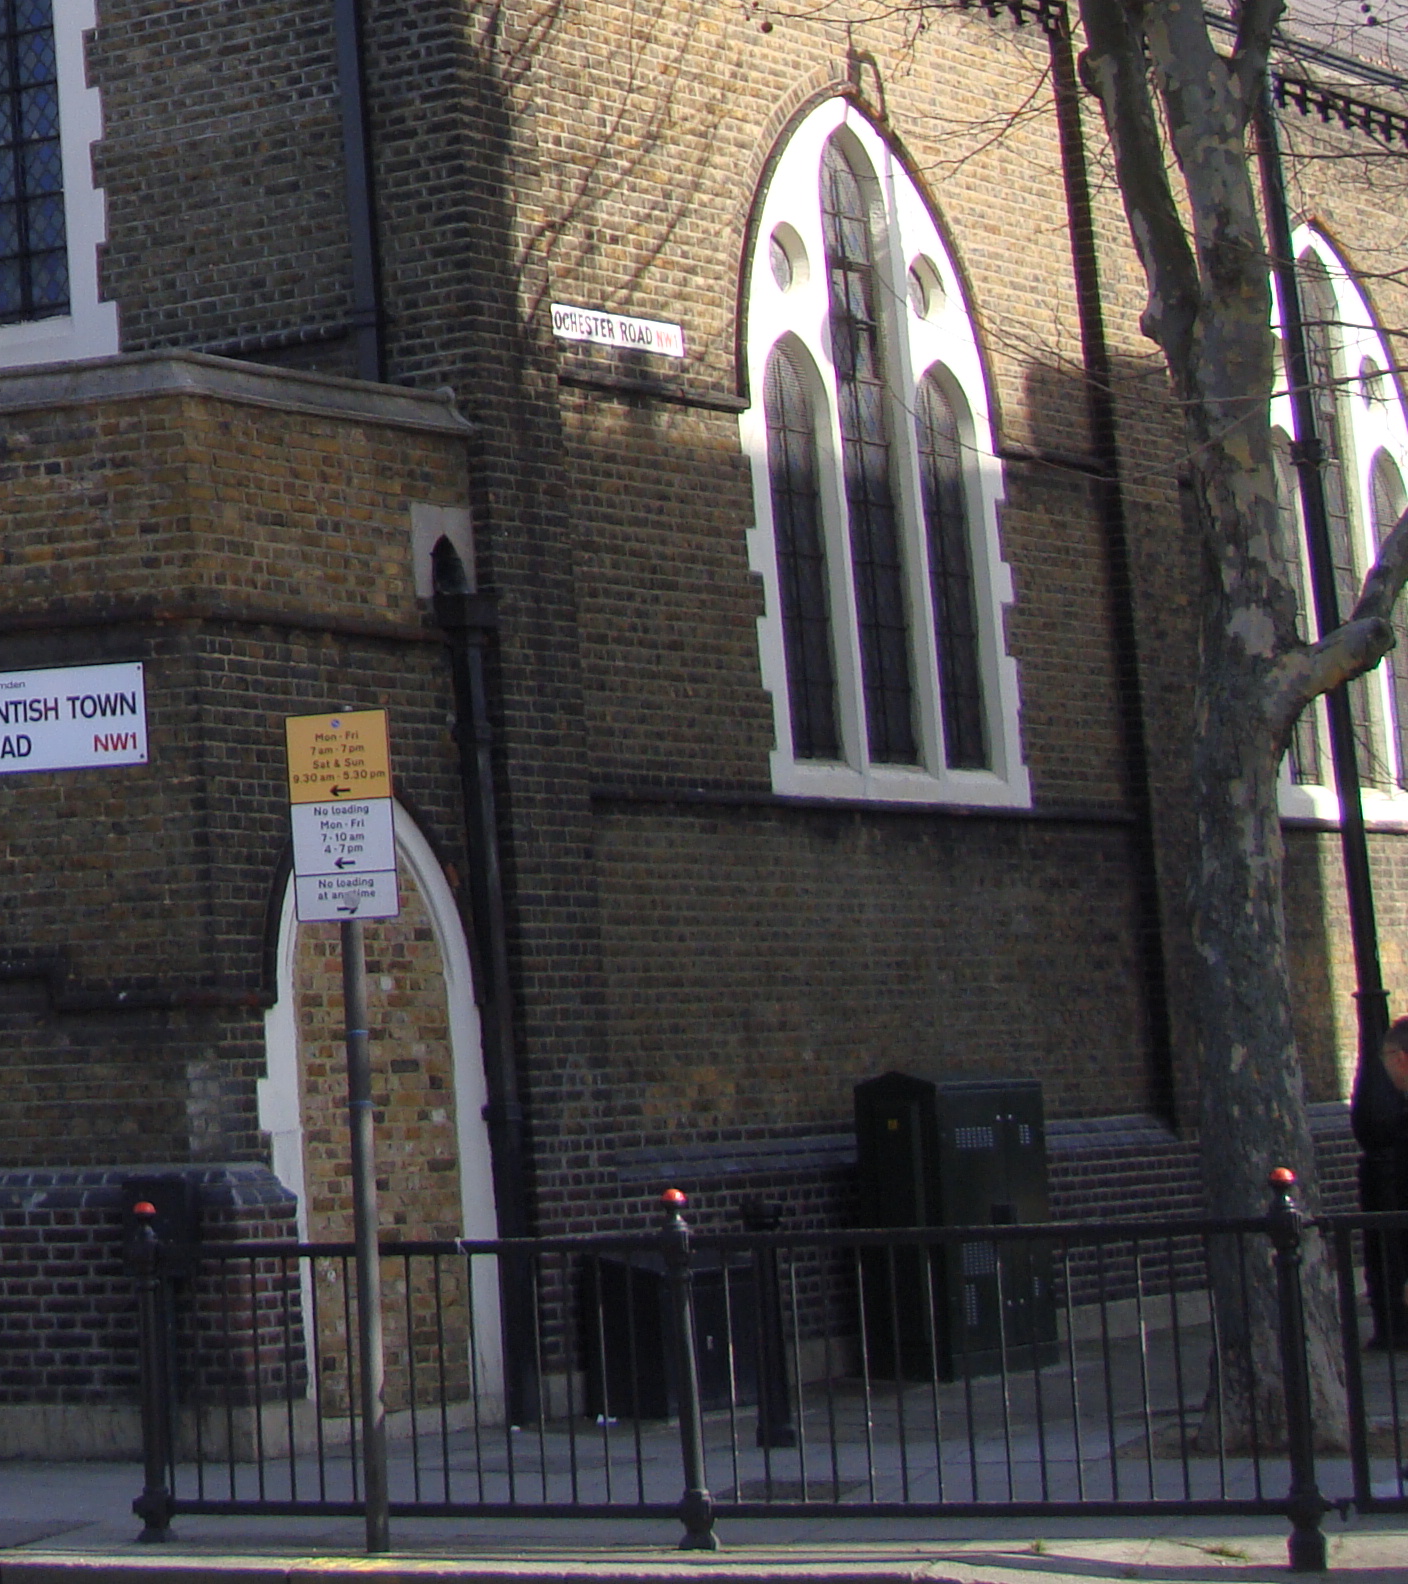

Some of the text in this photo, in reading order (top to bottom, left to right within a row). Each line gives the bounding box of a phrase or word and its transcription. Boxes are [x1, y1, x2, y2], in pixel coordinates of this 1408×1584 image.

[620, 320, 652, 345] ROAD
[656, 330, 678, 349] NW1
[67, 691, 136, 719] TOWN
[94, 732, 137, 752] NW1
[315, 733, 336, 742] Mon
[345, 731, 359, 740] Fri
[310, 747, 316, 755] 7
[341, 744, 347, 752] 7
[349, 745, 365, 754] pm
[313, 760, 330, 769] Sat
[344, 758, 365, 767] Sun
[293, 774, 317, 783] 9.30
[370, 771, 386, 780] pm
[314, 804, 369, 816] No loading
[320, 821, 342, 830] Mon
[351, 819, 365, 828] Fri
[321, 834, 327, 843] 7
[336, 833, 347, 842] 10
[324, 845, 331, 853] 4
[339, 844, 345, 852] 7
[347, 845, 363, 854] pm
[318, 877, 374, 889] No loading
[318, 891, 328, 899] at
